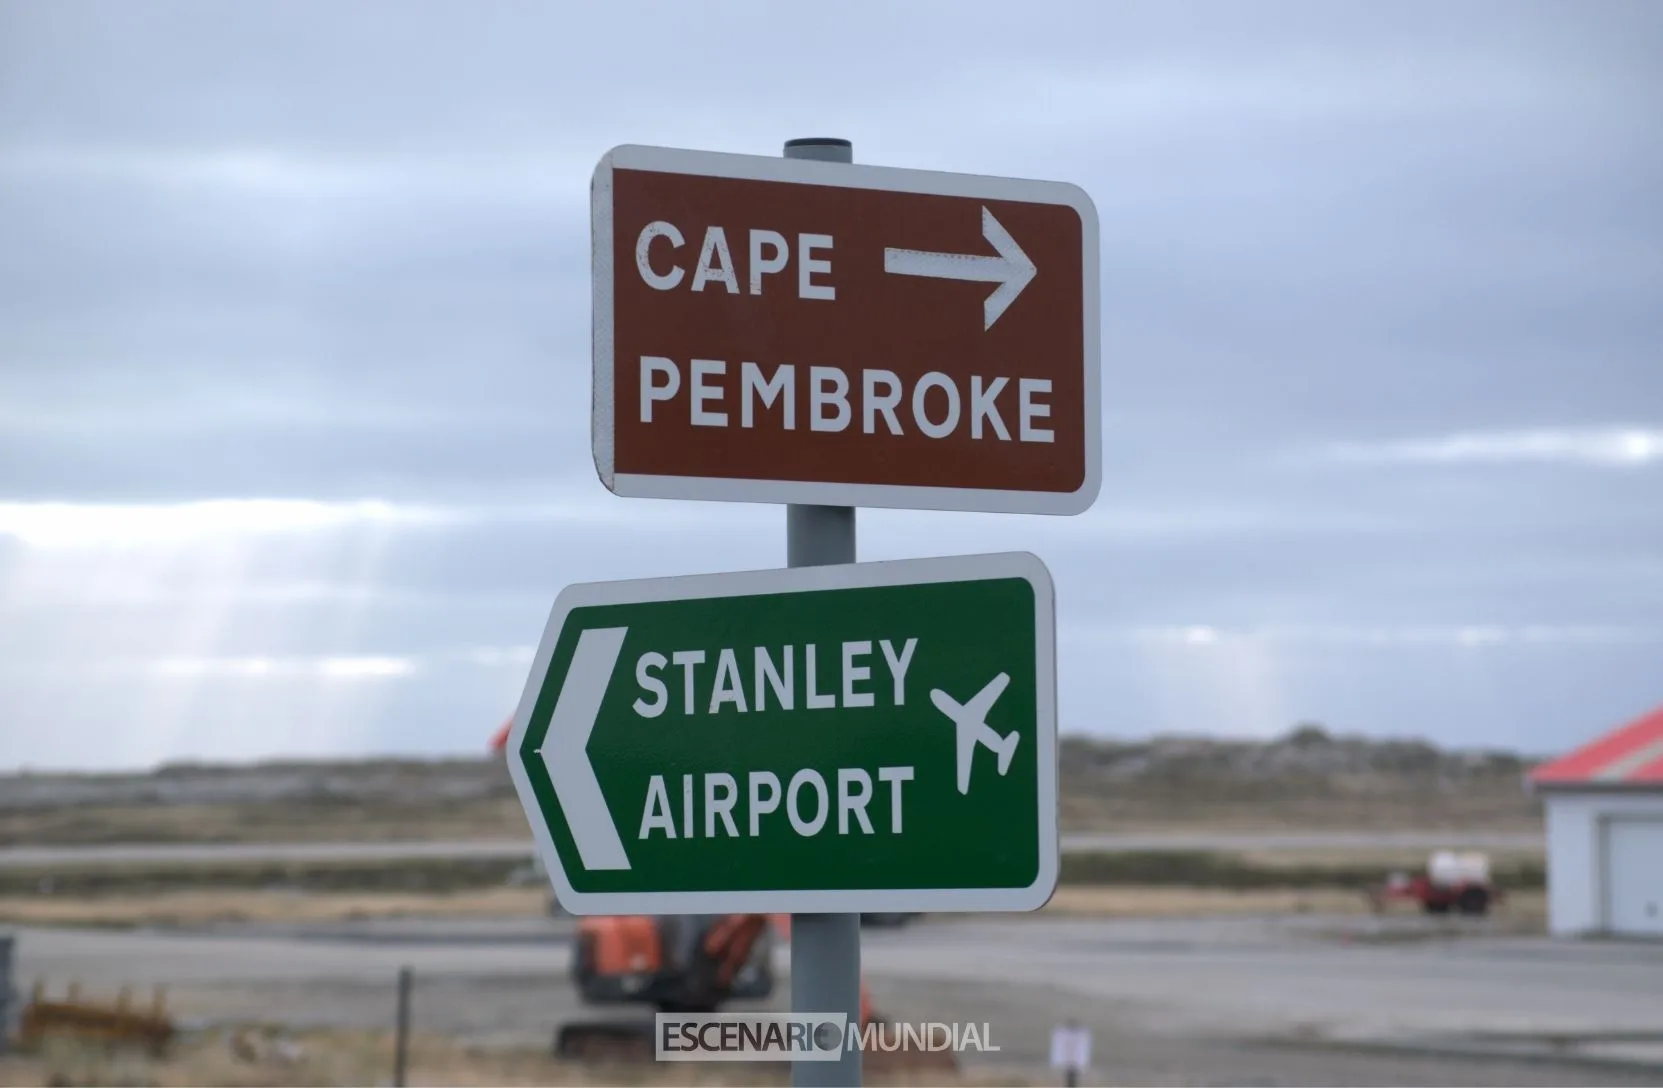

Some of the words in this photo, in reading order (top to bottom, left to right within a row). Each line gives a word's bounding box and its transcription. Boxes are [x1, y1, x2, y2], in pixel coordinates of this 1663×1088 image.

[636, 221, 836, 300] CAPE
[640, 356, 1055, 443] PEMBROKE
[633, 638, 918, 718] STANLEY
[639, 766, 914, 839] AIRPORT
